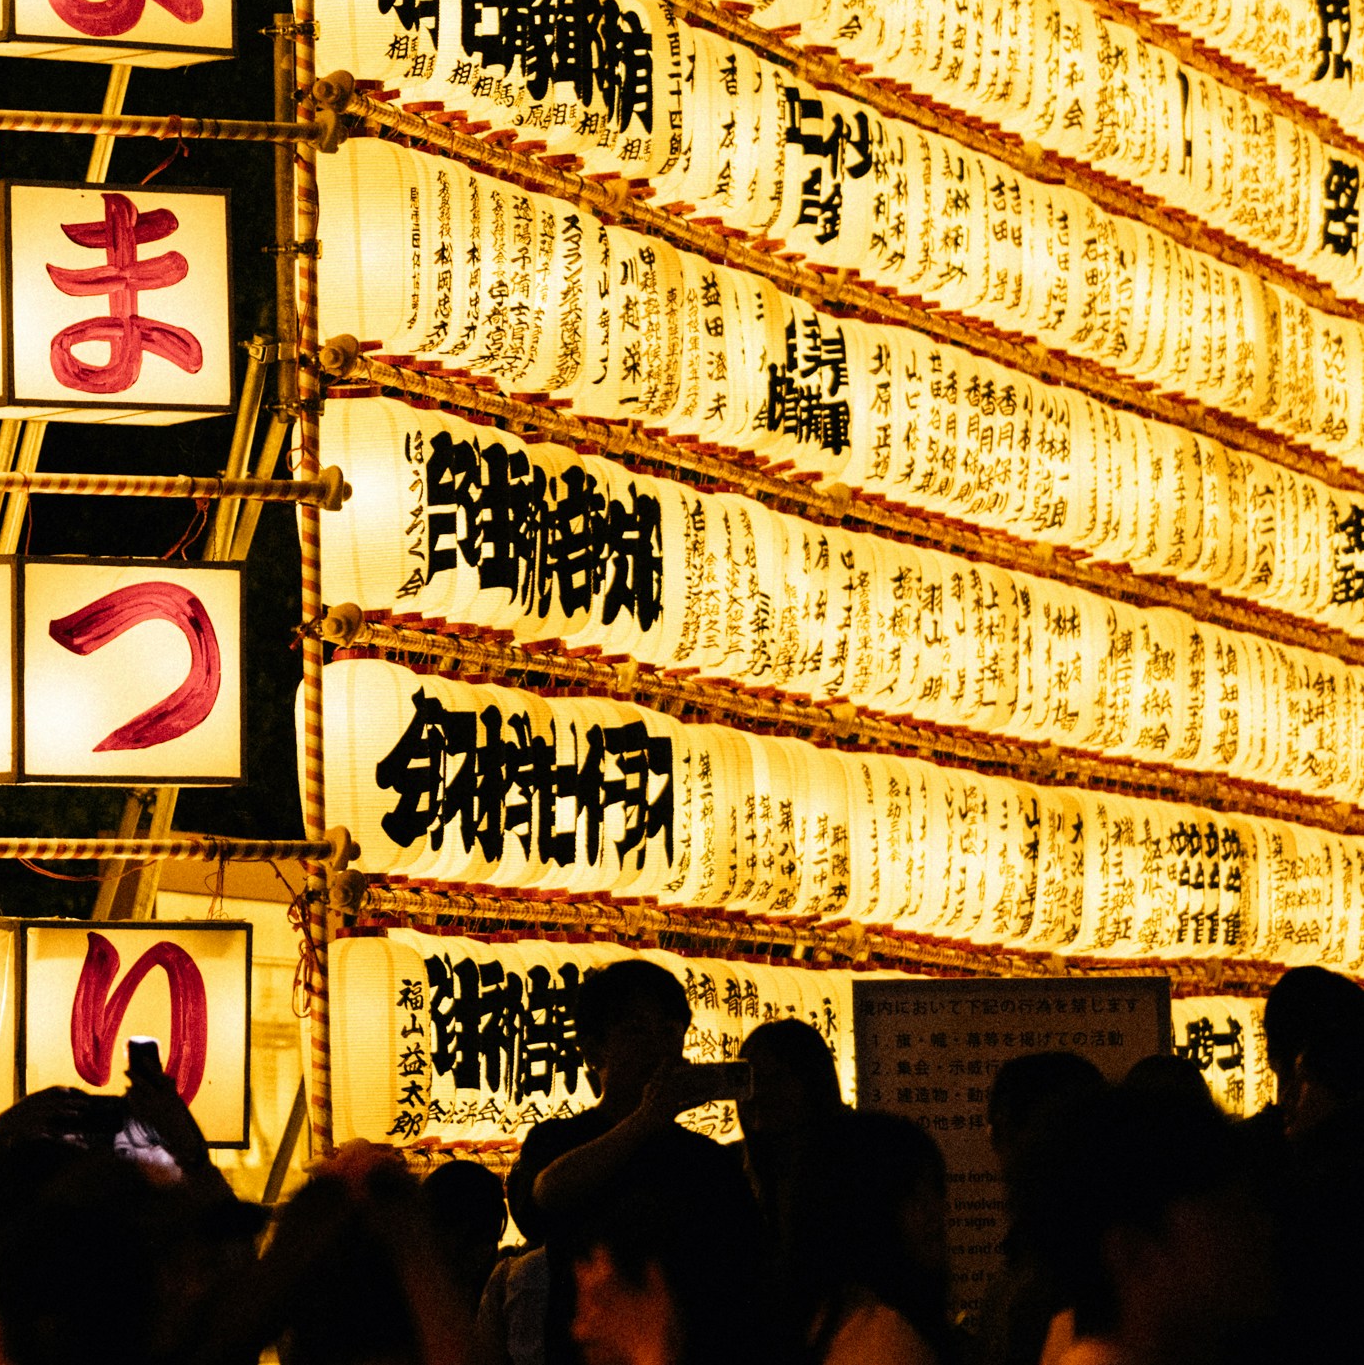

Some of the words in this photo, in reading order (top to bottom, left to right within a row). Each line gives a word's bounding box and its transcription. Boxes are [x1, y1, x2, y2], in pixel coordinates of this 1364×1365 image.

[45, 191, 205, 394] ま
[48, 580, 222, 753] つ
[71, 931, 207, 1107] り
[386, 978, 426, 1140] 福山益太郎
